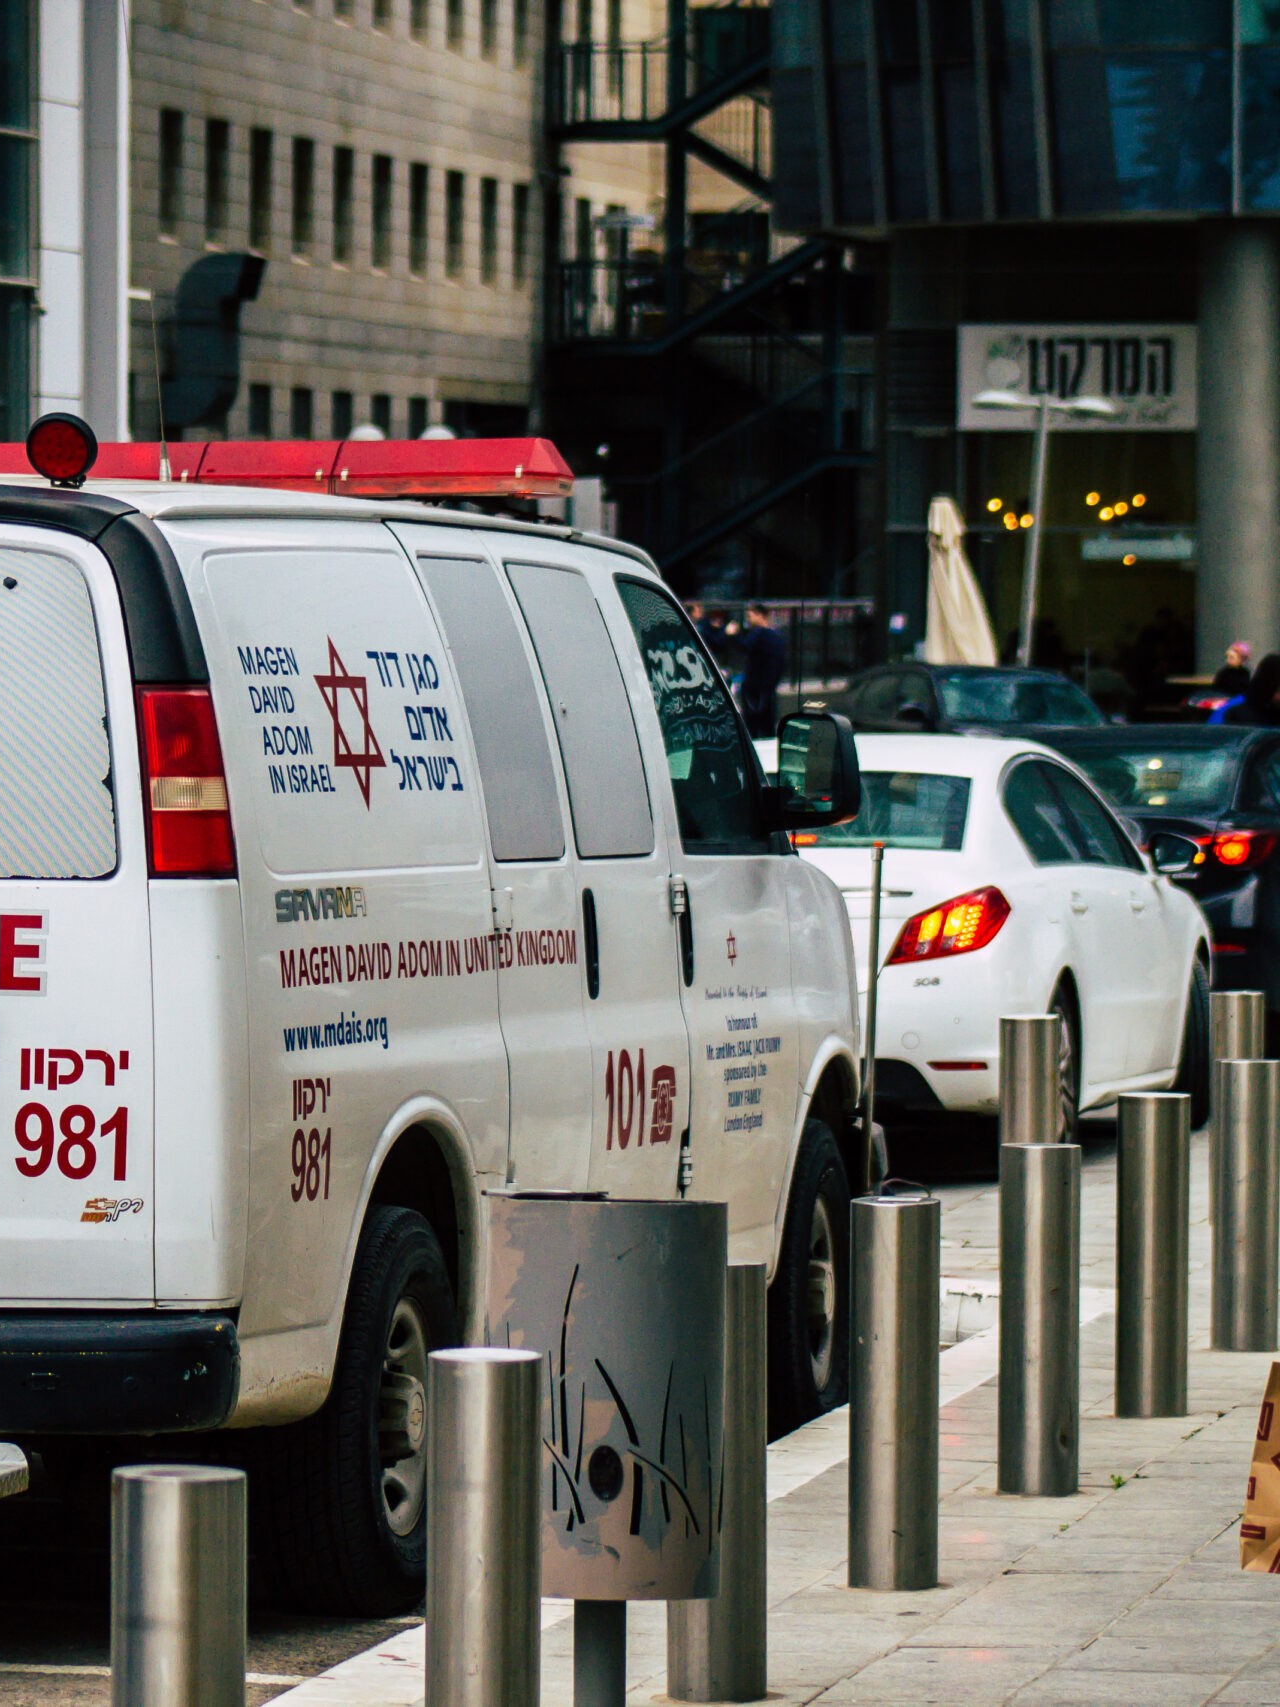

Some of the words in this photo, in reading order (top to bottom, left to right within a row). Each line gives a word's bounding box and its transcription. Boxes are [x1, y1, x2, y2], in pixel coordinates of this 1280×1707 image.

[237, 646, 300, 676] MAGEN
[366, 651, 405, 688] דוד
[405, 653, 440, 695] מגן
[248, 686, 295, 714] DAVID
[262, 726, 313, 756] ADOM
[404, 705, 454, 742] אדום
[269, 765, 286, 794] IN
[288, 764, 336, 793] ISRAEL
[390, 749, 464, 792] בישראל
[279, 945, 342, 989] MAGEN
[345, 943, 392, 982] DAVID
[398, 940, 443, 979] ADOM
[446, 938, 461, 977] IN
[464, 932, 513, 974] UNITED
[516, 929, 577, 967] KINGDOM
[283, 1011, 389, 1052] www.mdais.org
[20, 1047, 130, 1091] ירקון
[292, 1077, 331, 1122] ירקון
[605, 1047, 646, 1151] 101
[14, 1102, 129, 1182] 981
[290, 1127, 332, 1203] 981
